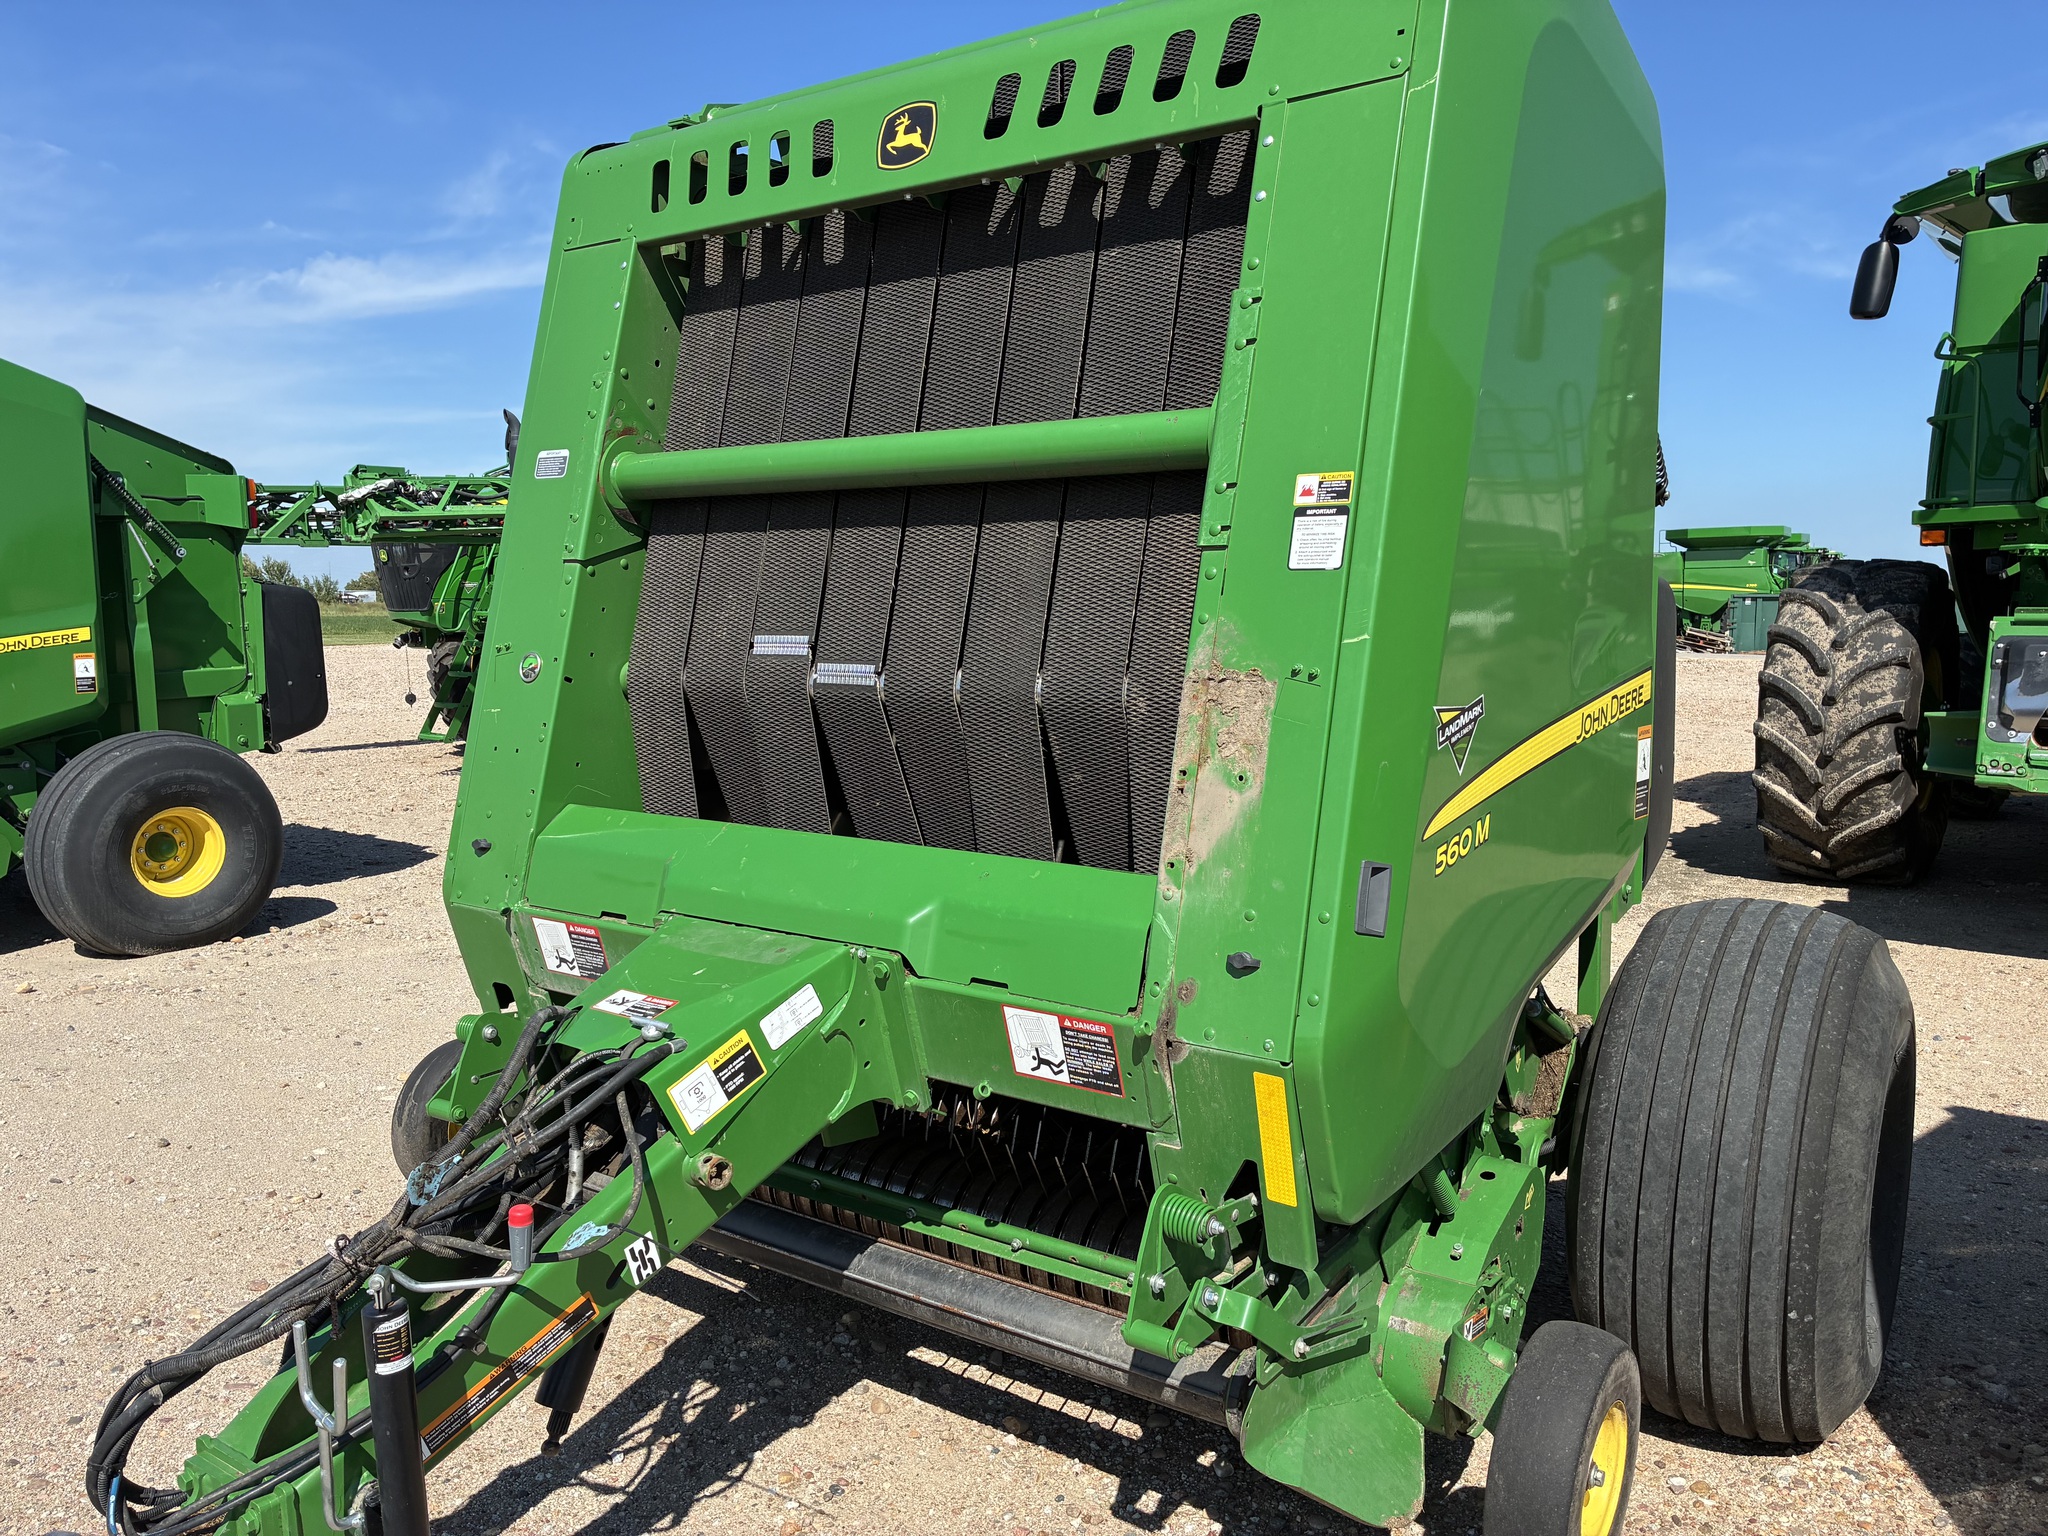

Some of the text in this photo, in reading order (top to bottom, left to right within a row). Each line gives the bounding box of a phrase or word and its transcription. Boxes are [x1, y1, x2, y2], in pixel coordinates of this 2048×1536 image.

[0, 633, 79, 652] OHN DEERE
[1440, 703, 1482, 742] LANDMARK
[1577, 684, 1644, 740] JOHN DEERE
[1451, 722, 1474, 744] IMPLEMENT
[1435, 811, 1491, 878] 560 M
[574, 926, 596, 934] DANGER
[1072, 1020, 1106, 1033] DANGER
[719, 1037, 744, 1060] CAUTION
[378, 1324, 392, 1332] JOHN
[495, 1346, 528, 1374] WARNING
